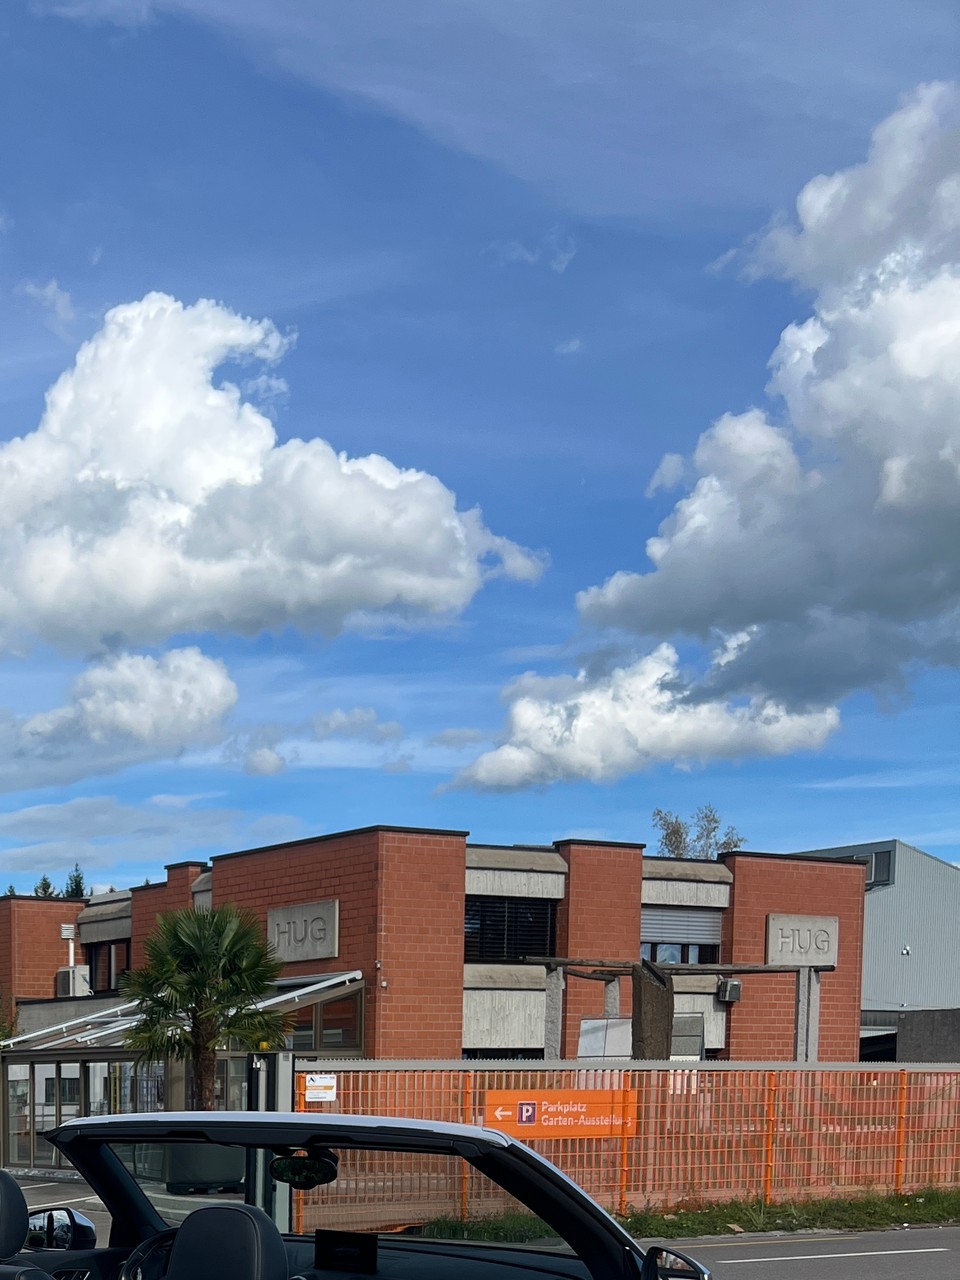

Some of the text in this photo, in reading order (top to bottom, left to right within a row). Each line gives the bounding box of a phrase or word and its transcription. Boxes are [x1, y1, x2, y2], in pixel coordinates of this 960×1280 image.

[275, 916, 327, 949] HUG
[778, 927, 830, 954] HUG
[541, 1101, 587, 1114] Parkplatz
[541, 1114, 631, 1127] Garten-Ausstellug
